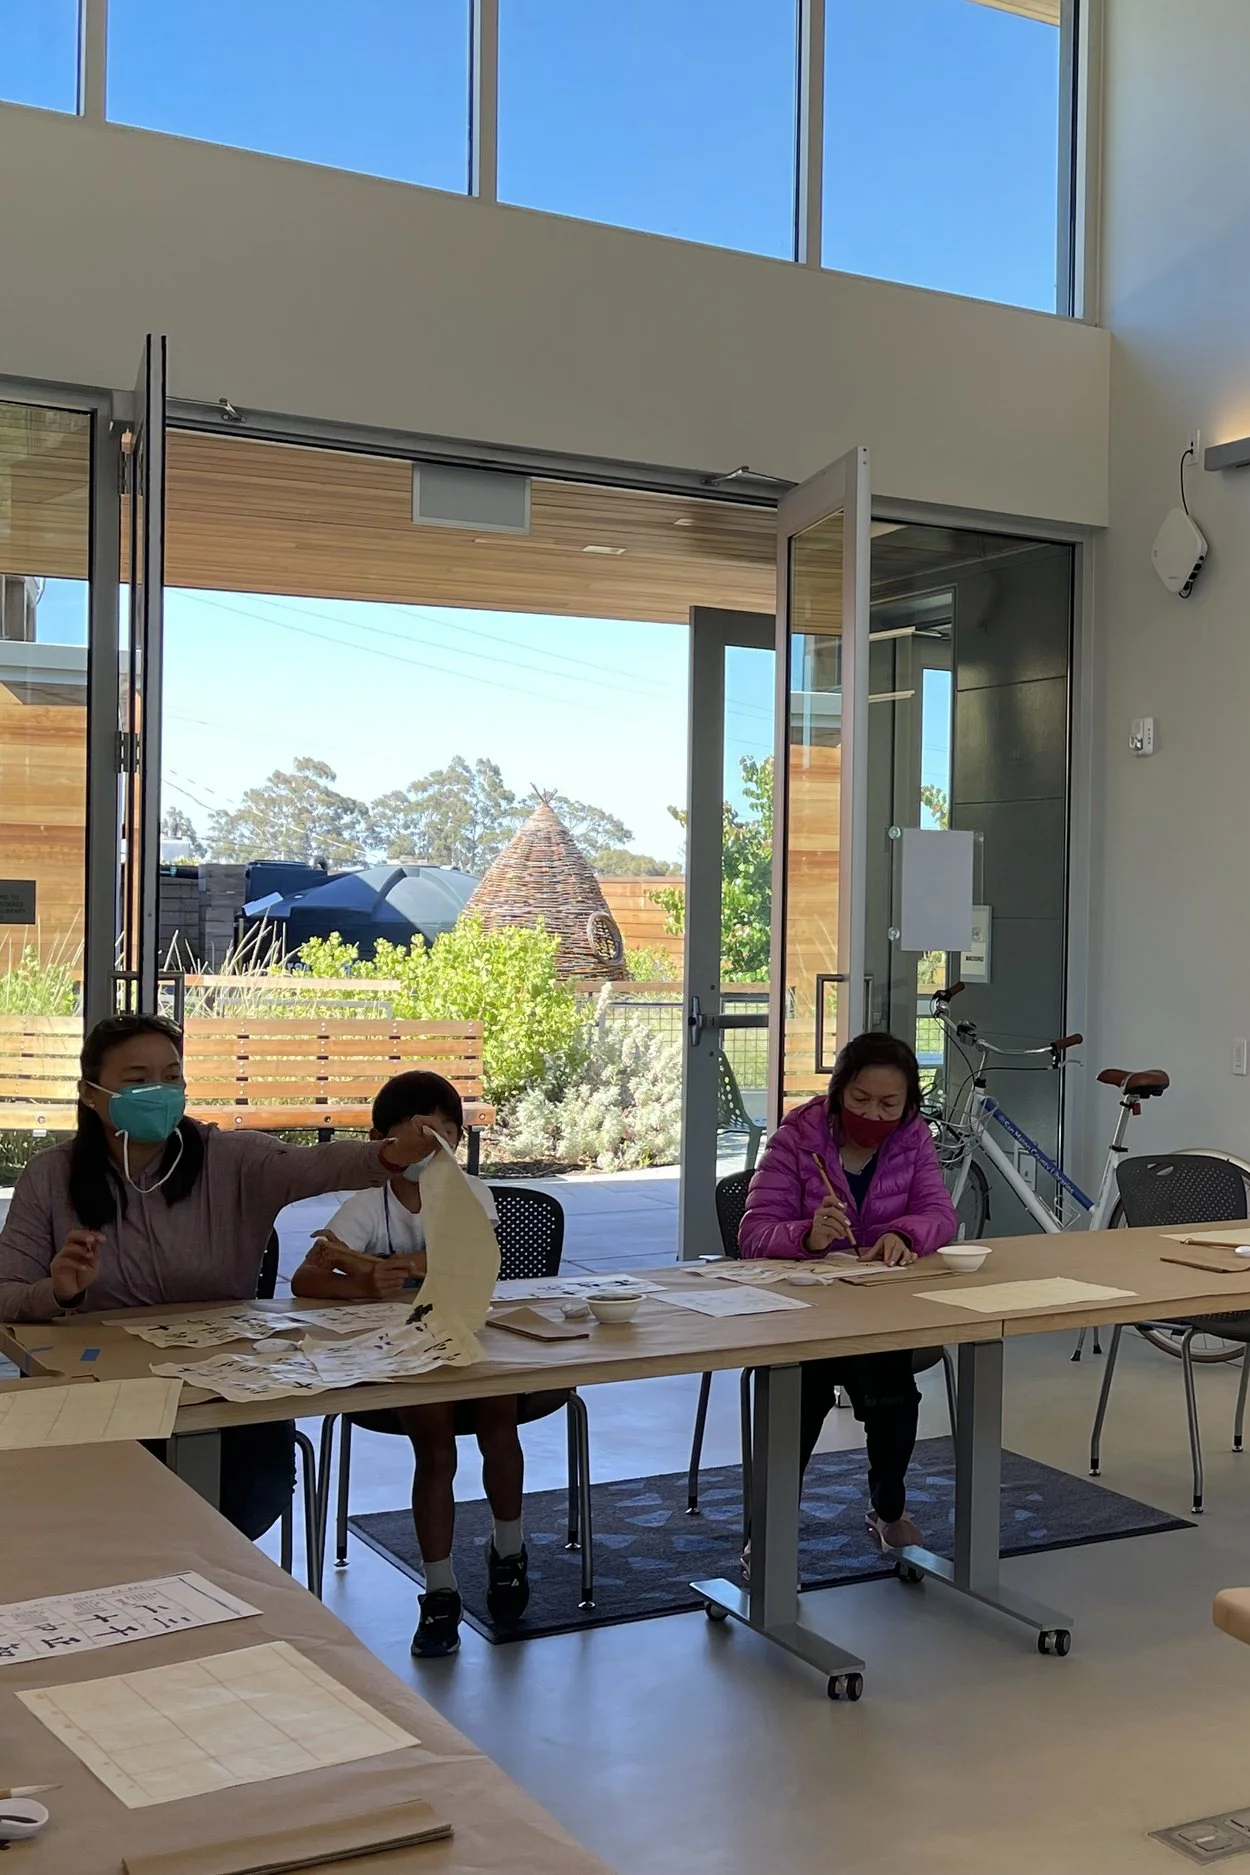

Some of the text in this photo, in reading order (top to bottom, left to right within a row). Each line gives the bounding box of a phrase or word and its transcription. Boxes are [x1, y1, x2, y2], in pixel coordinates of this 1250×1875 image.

[1003, 1120, 1075, 1194] San Mateo County Libraries
